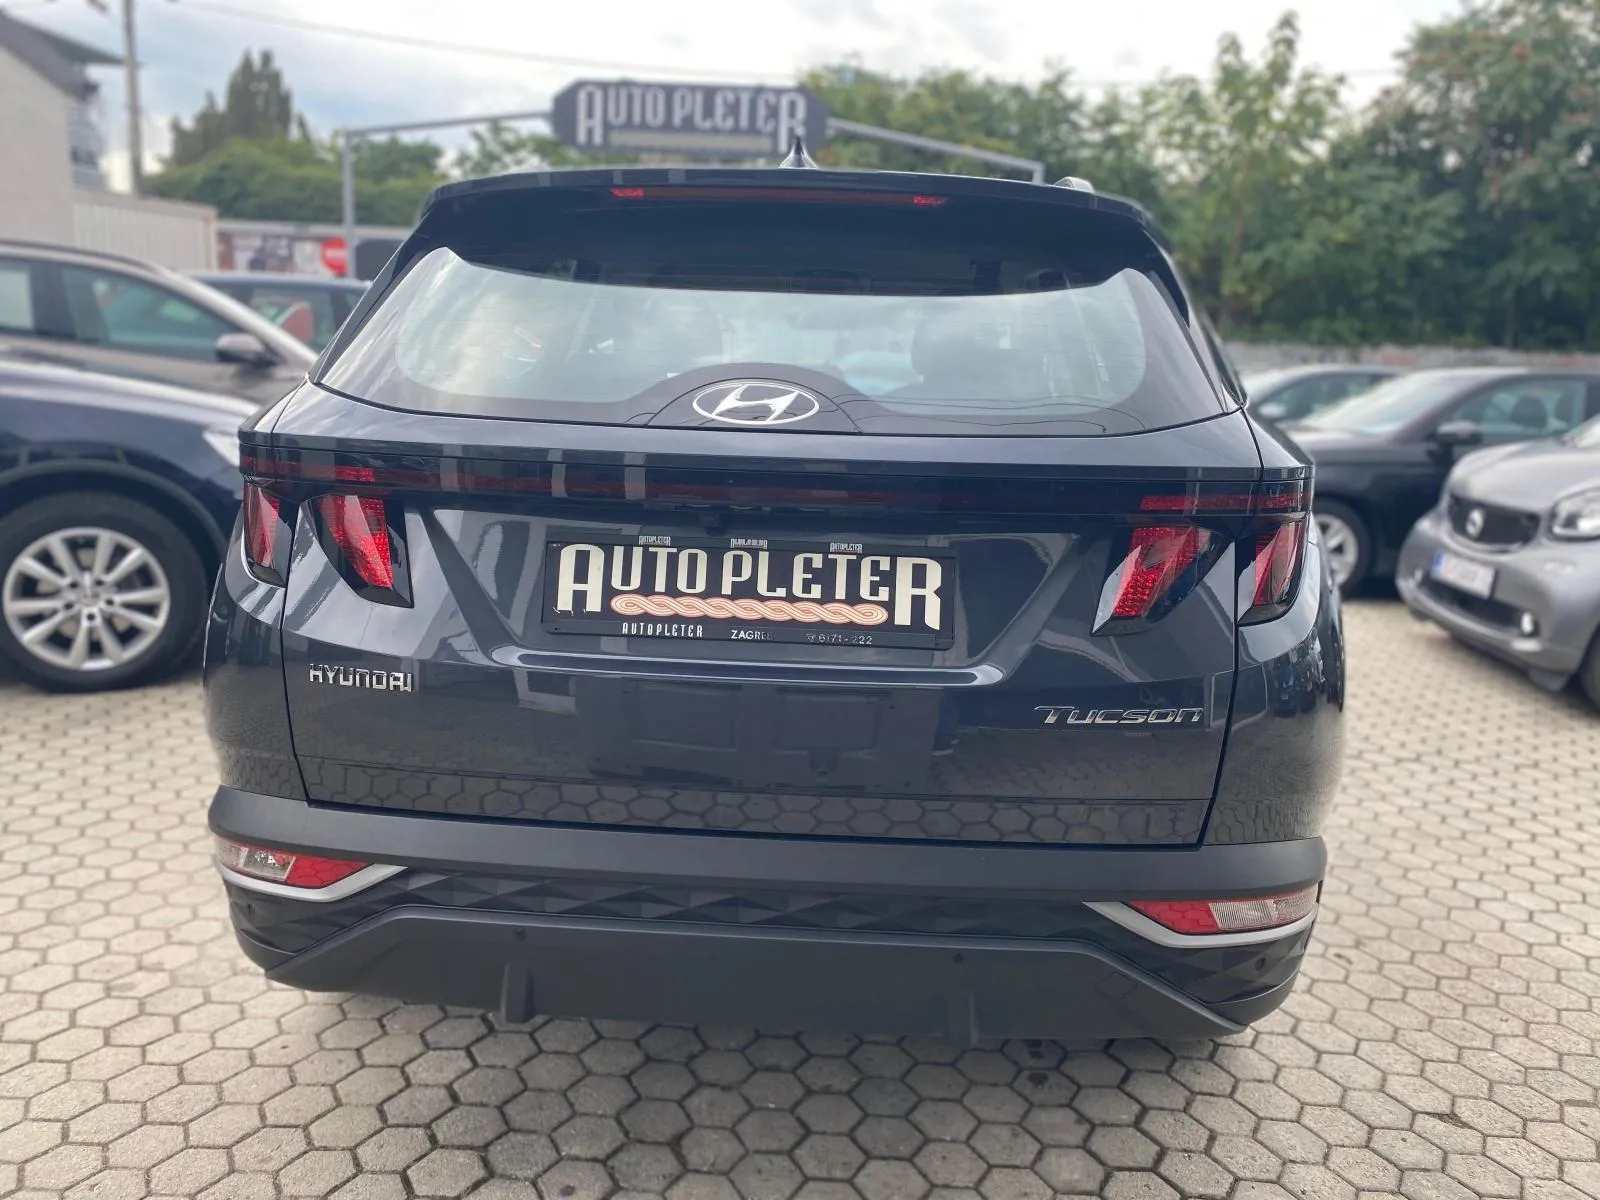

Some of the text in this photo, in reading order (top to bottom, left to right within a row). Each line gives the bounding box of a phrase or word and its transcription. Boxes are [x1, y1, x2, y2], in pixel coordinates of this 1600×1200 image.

[575, 84, 808, 155] AUTO PLETER
[556, 543, 942, 631] AUTO PLETER
[622, 622, 703, 638] AUTOPLETER
[309, 663, 412, 693] HYUNDAI
[1034, 705, 1204, 724] TUCSON
